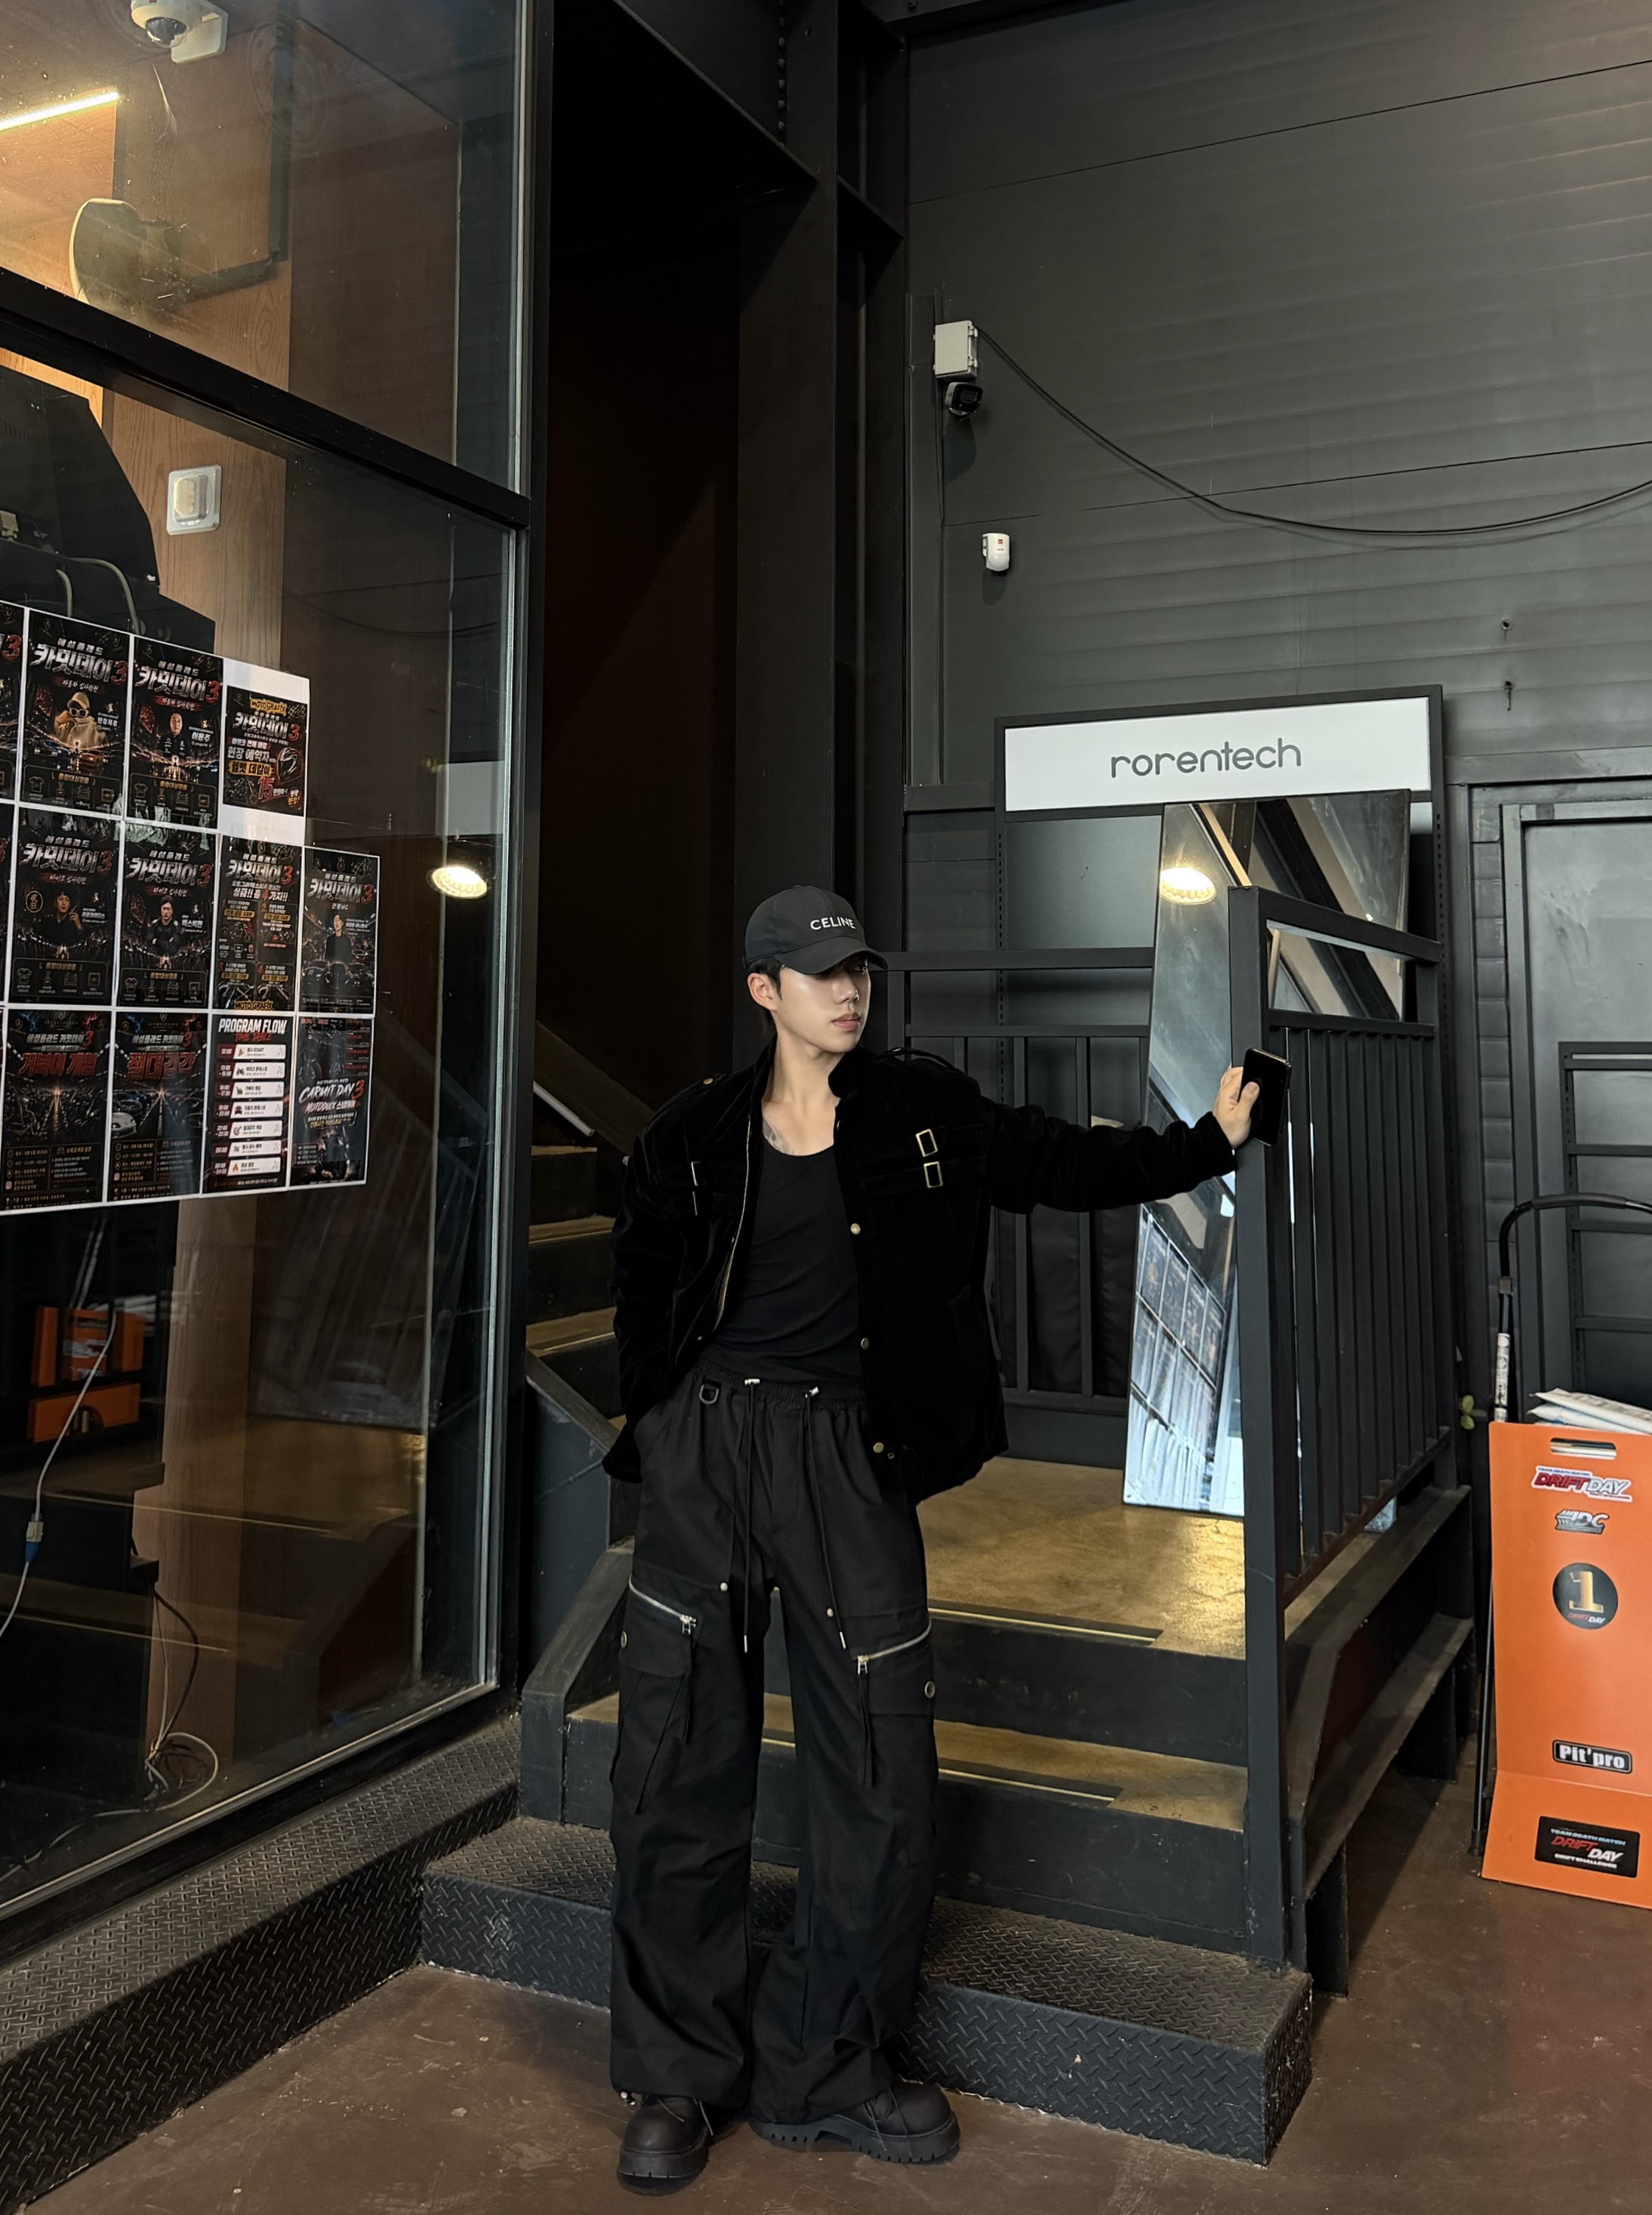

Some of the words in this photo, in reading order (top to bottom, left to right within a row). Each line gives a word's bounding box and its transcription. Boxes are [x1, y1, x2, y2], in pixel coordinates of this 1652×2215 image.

[1111, 737, 1302, 779] rorentech
[810, 917, 856, 930] CELINE
[218, 1018, 262, 1033] PROGRAM
[262, 1019, 288, 1035] FLOW
[299, 1084, 336, 1103] CARMIT
[334, 1083, 356, 1100] DAY
[1569, 1571, 1604, 1612] 1
[1559, 1744, 1625, 1769] Pit'pro
[1550, 1835, 1598, 1851] DRIFT
[1551, 1828, 1572, 1837] TEAM
[1572, 1833, 1598, 1841] DEATH
[1598, 1837, 1626, 1846] MATCH
[1554, 1853, 1576, 1862] DRIFT
[1587, 1848, 1624, 1862] DAY
